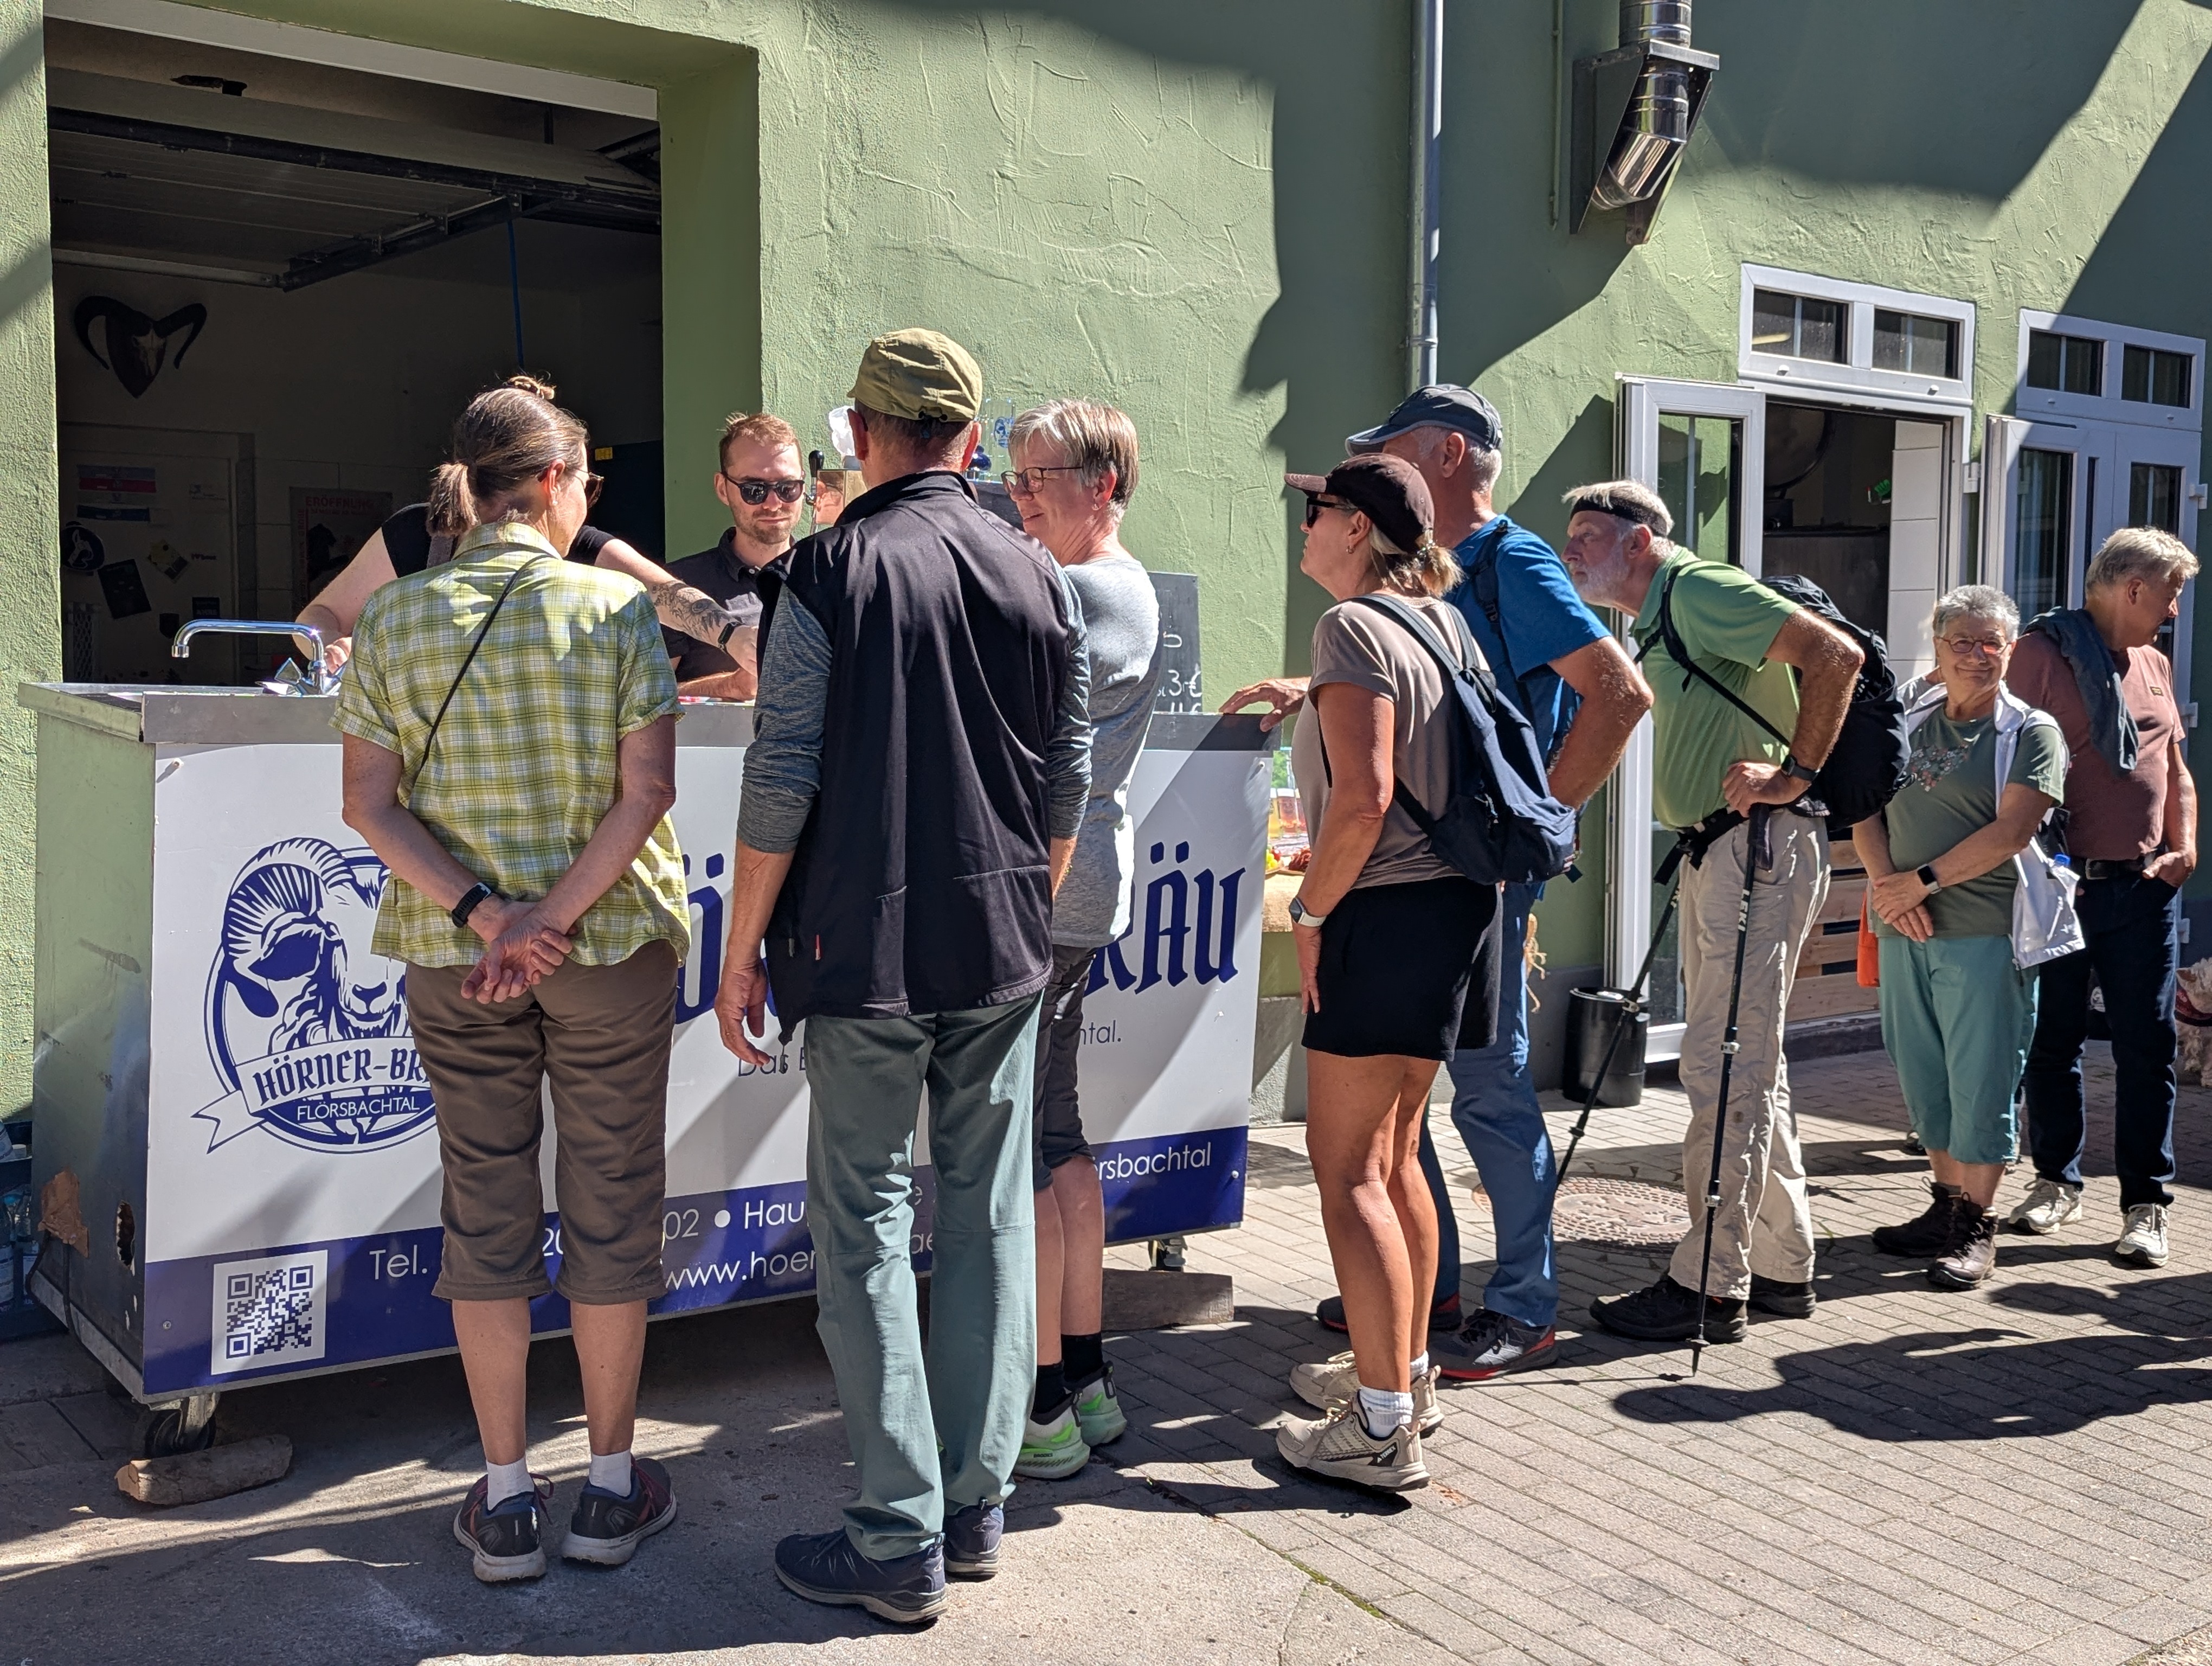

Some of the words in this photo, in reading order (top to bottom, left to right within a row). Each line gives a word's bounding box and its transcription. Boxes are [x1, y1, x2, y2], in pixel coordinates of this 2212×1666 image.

[1738, 889, 1750, 932] LEKI
[252, 1048, 430, 1106] HÖRNER-BR
[297, 1096, 420, 1120] FLÖRSBACHTAL
[369, 1244, 428, 1280] Tel.
[744, 1200, 806, 1229] Hau
[1092, 1142, 1211, 1181] rsbachtal
